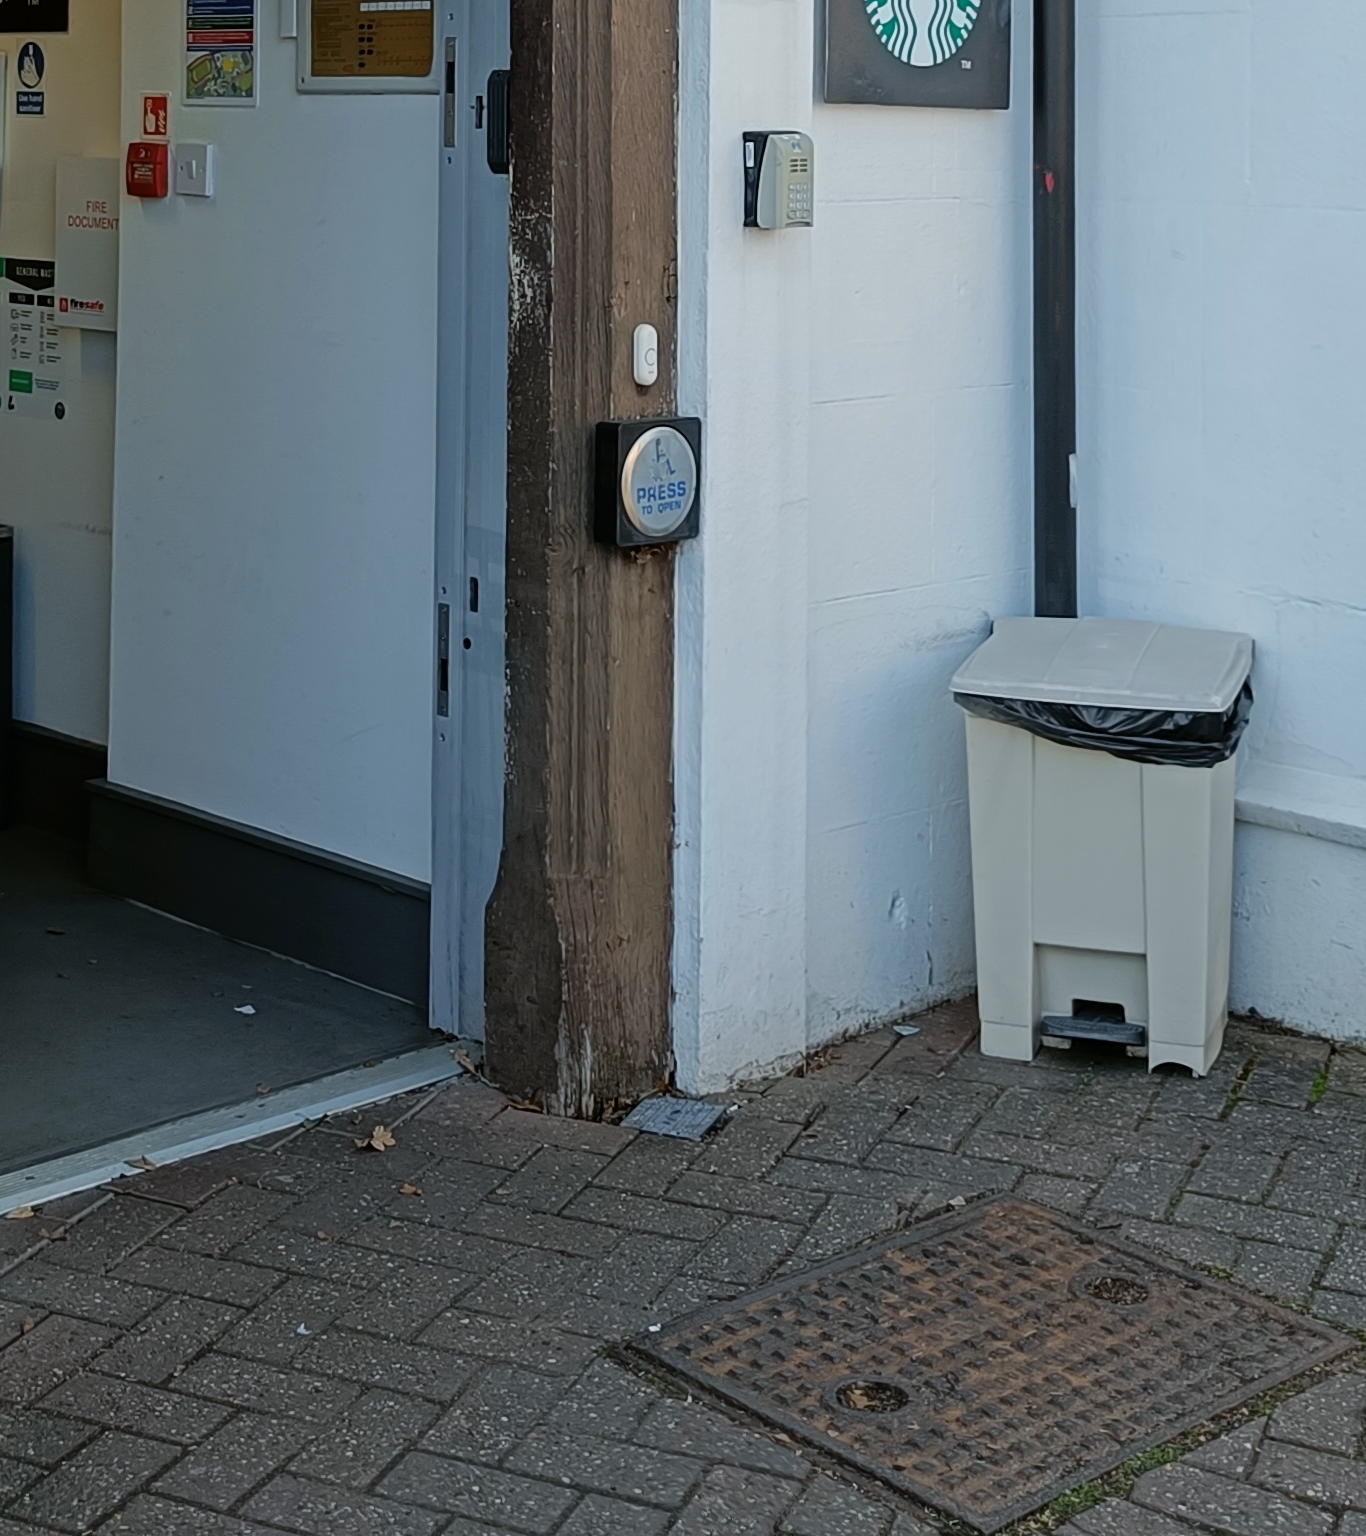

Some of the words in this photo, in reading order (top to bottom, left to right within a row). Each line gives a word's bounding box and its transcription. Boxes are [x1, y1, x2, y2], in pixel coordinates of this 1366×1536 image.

[86, 201, 107, 213] FIRE
[68, 215, 119, 230] DOCUMENT
[70, 299, 104, 311] firesafe
[637, 481, 686, 504] PRESS
[642, 505, 653, 515] TO
[658, 501, 681, 514] OPEN
